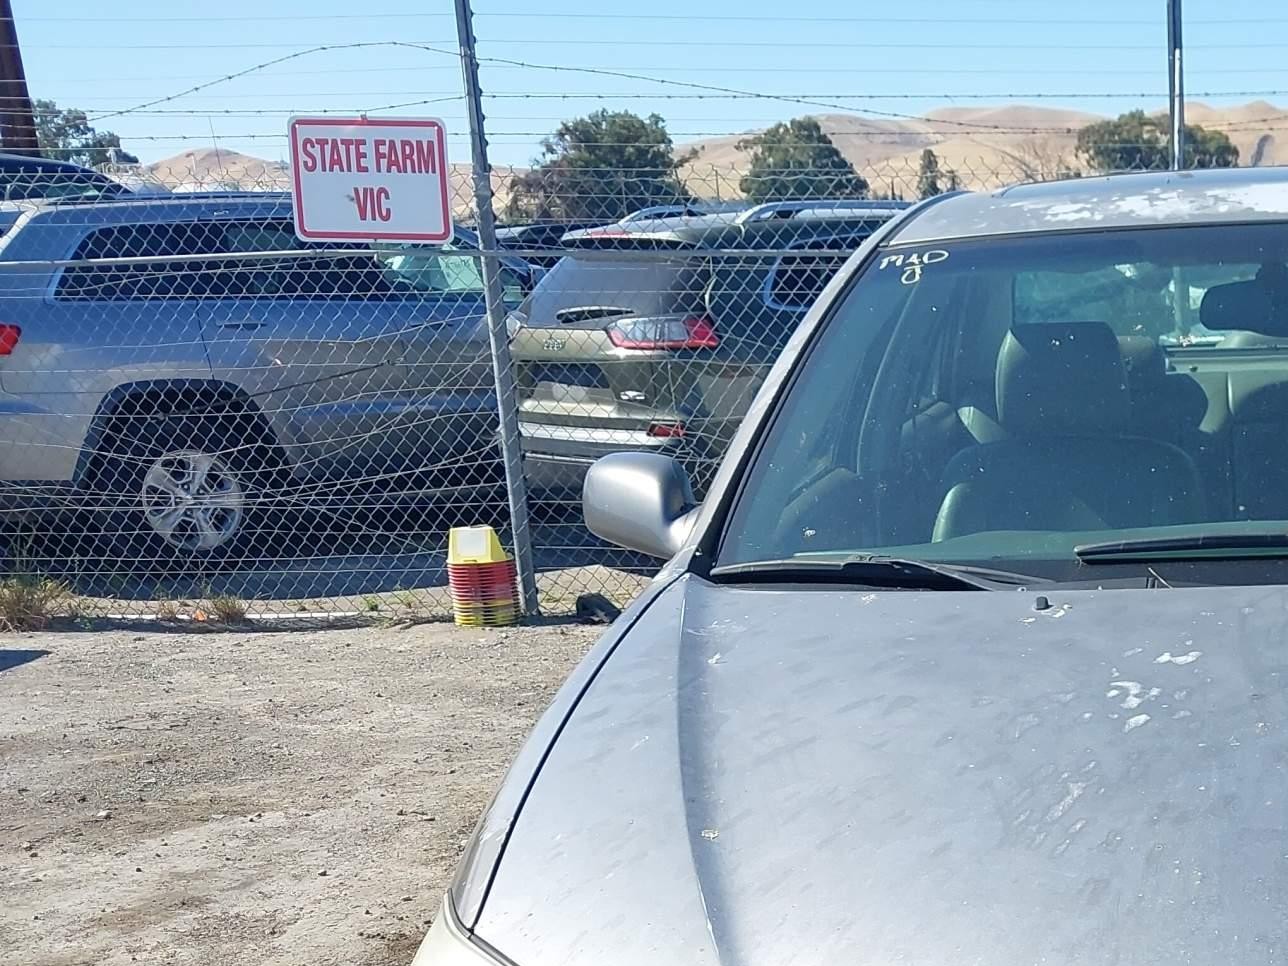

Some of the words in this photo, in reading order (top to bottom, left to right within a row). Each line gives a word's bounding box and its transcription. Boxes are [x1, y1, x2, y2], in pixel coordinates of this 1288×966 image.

[302, 137, 369, 173] STATE
[373, 139, 437, 174] FARM
[353, 187, 392, 222] VIC
